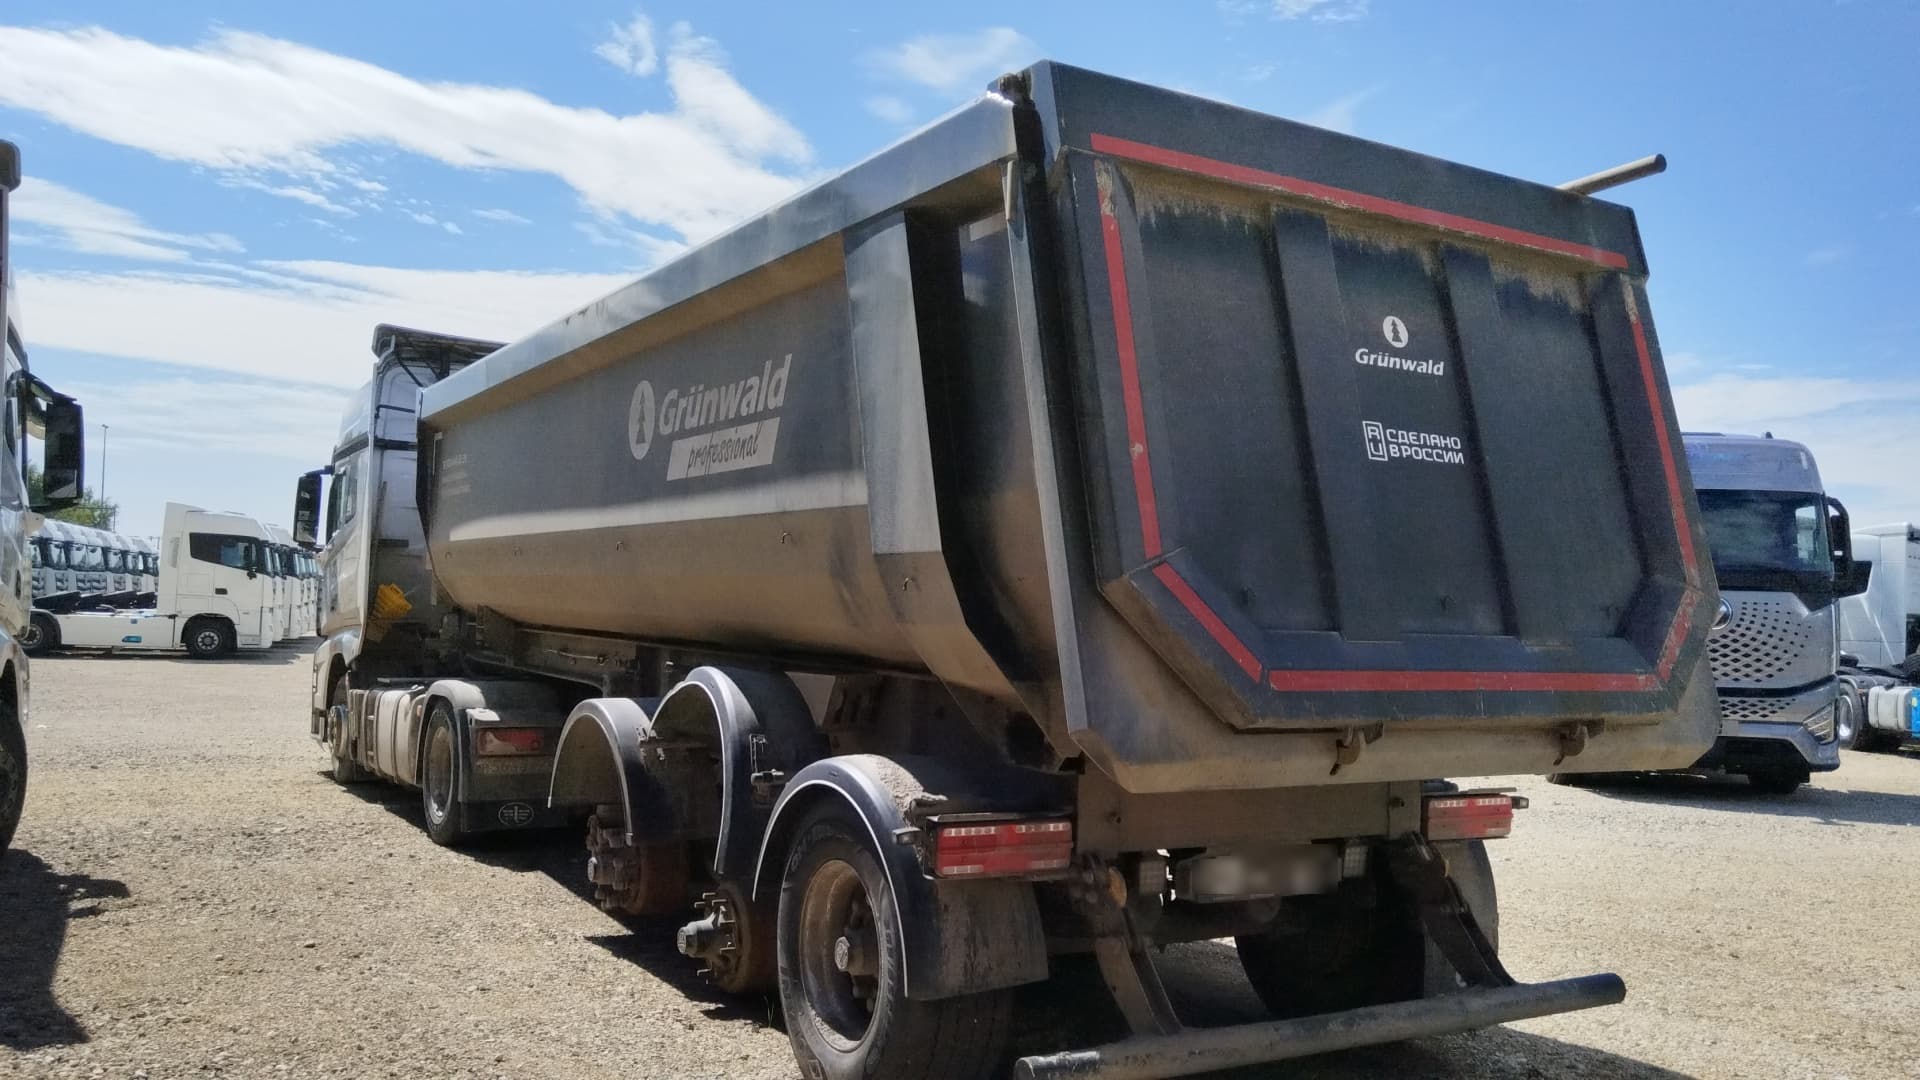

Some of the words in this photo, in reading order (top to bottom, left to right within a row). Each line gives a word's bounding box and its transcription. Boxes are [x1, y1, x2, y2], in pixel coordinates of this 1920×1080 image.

[1355, 348, 1444, 376] Grünwald
[659, 353, 792, 435] Grünwald
[686, 420, 764, 478] professional
[1386, 428, 1461, 450] СДЕЛАНО
